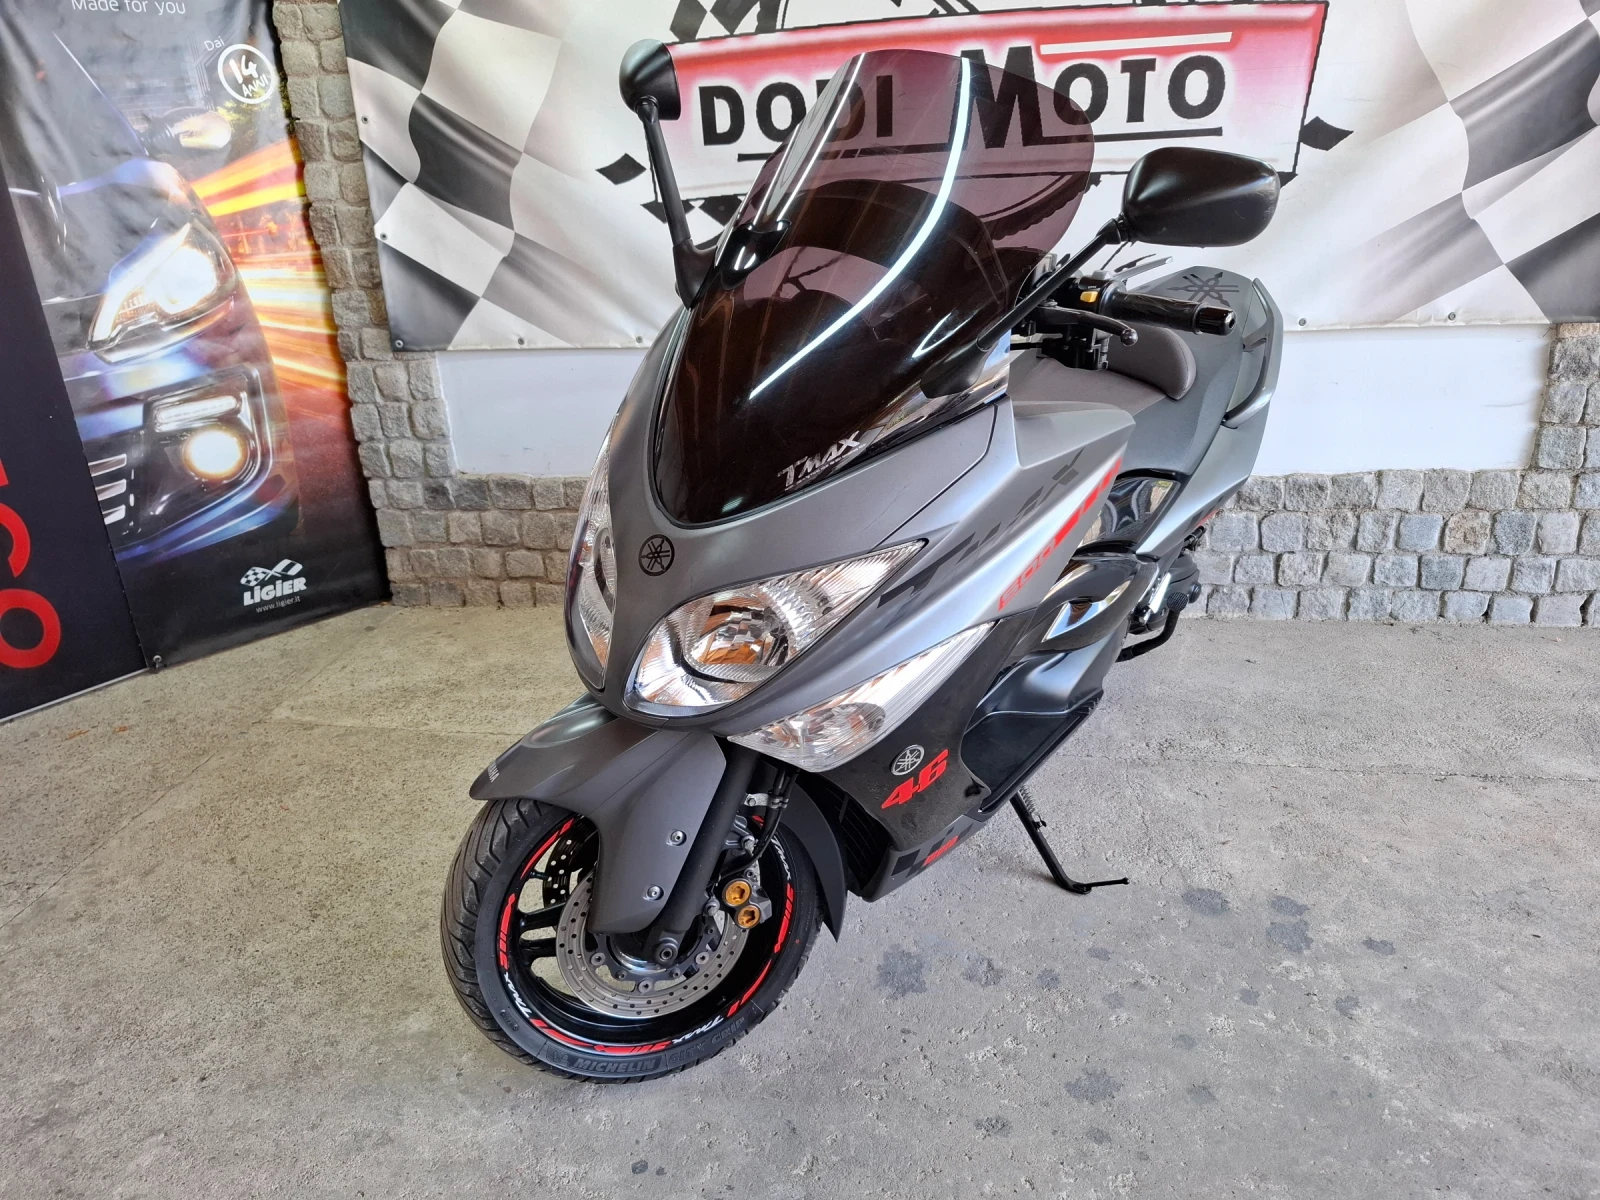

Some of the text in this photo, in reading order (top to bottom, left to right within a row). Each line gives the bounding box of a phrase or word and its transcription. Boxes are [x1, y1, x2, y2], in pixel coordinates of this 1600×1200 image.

[72, 0, 186, 16] Made for you
[203, 36, 226, 52] Dai
[228, 55, 258, 85] 14
[241, 77, 270, 99] ANNI
[698, 45, 1226, 150] DODI MOTO
[255, 595, 301, 613] www.ligier.it
[881, 748, 949, 810] 46
[573, 1056, 658, 1074] MICHELIN
